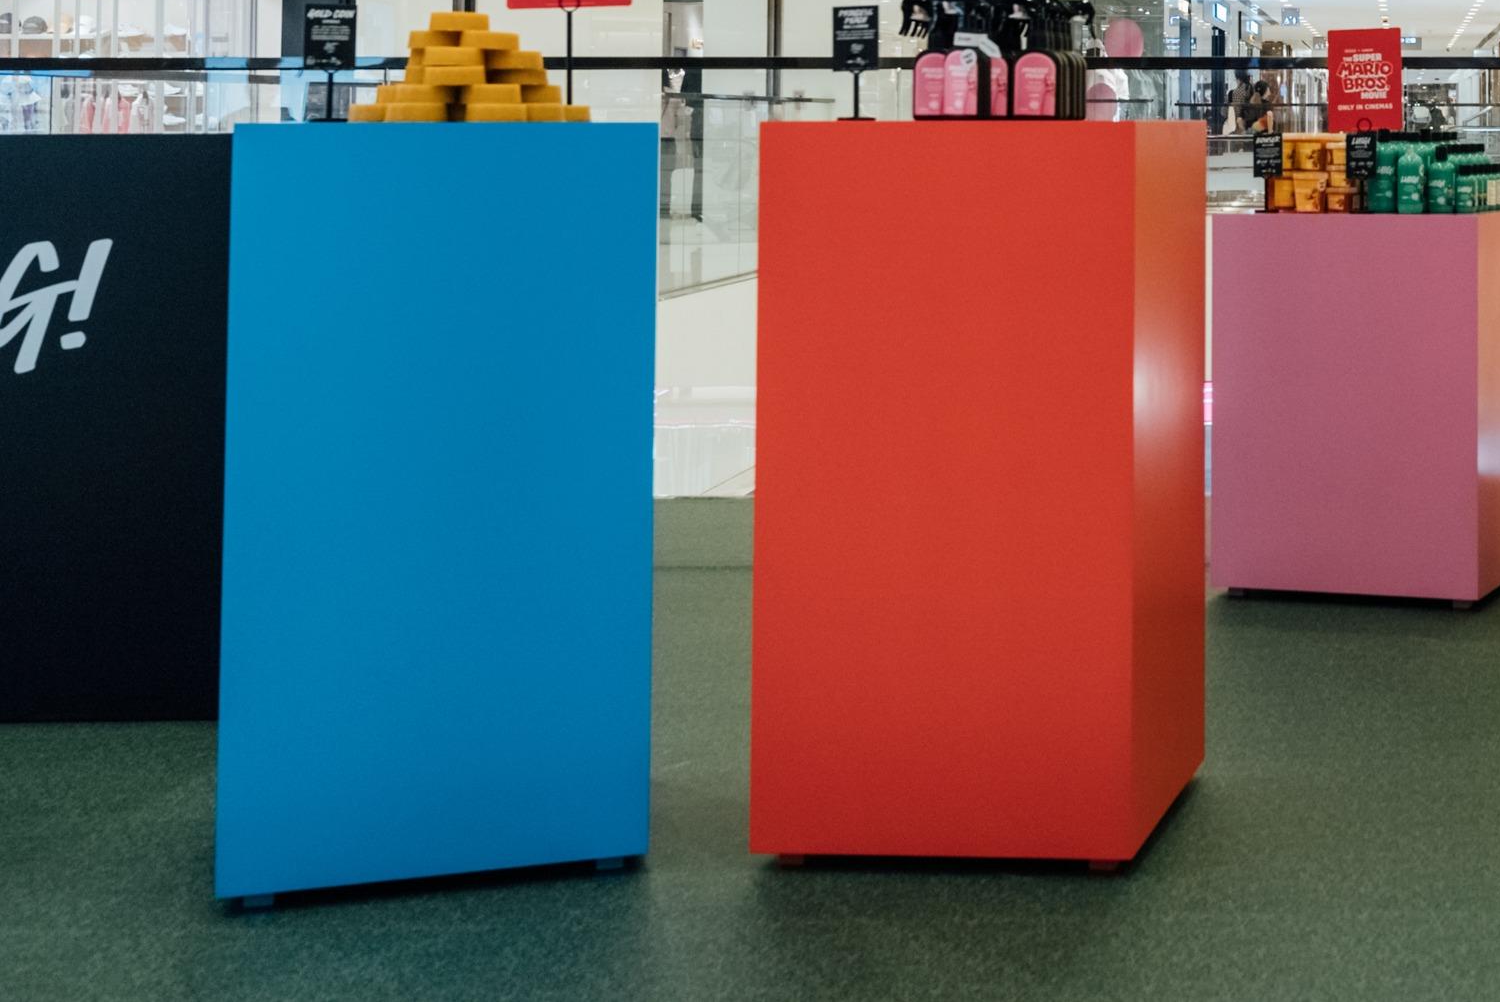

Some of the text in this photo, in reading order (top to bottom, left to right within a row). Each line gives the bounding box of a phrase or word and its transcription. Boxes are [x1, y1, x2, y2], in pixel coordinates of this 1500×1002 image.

[1353, 53, 1382, 62] SUPER
[1336, 61, 1393, 78] MARIO
[1342, 76, 1391, 93] BROS.
[1361, 91, 1387, 99] MOVIE
